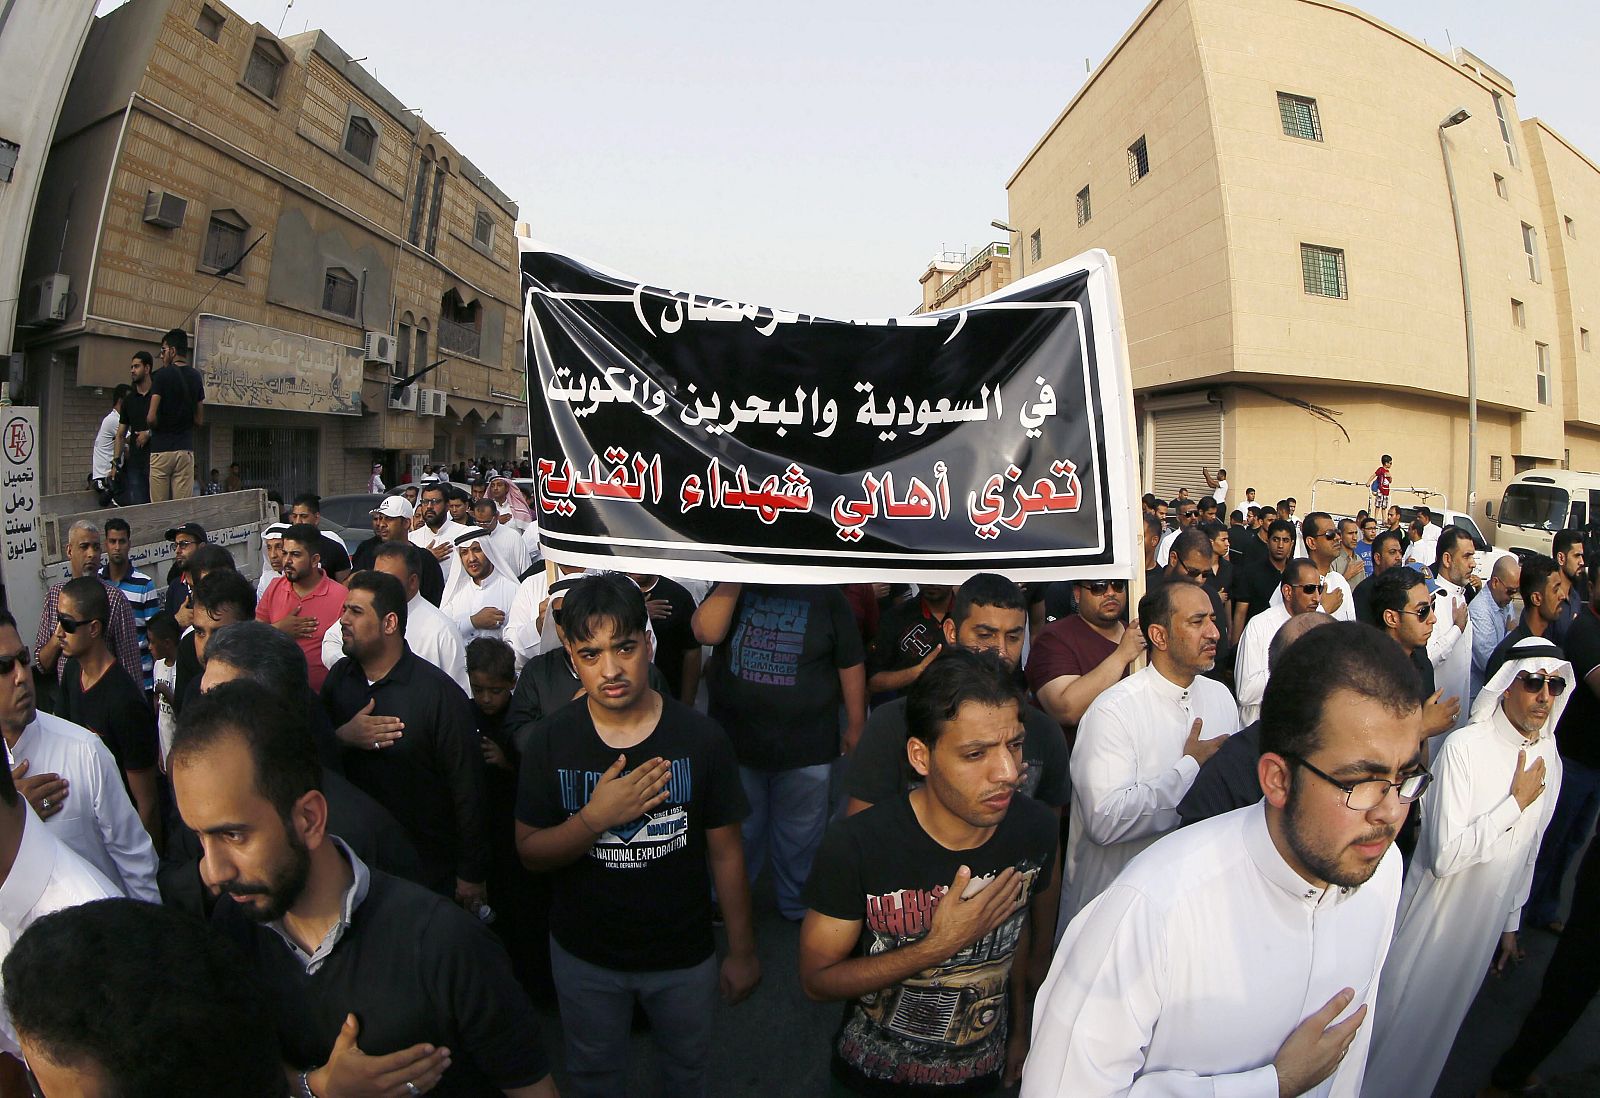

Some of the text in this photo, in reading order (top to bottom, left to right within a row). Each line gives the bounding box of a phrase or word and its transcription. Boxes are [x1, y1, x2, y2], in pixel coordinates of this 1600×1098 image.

[547, 366, 1057, 442] في السعودية والبحرين والكويت
[3, 466, 34, 488] تحميل
[5, 493, 34, 514] رمل
[536, 446, 1083, 543] تعزي أهالي شهداء القديح
[5, 516, 36, 536] اسمنت
[229, 528, 251, 540] مؤسسة
[7, 540, 38, 560] طابوق
[596, 848, 636, 862] NATIONAL
[636, 834, 687, 861] EXPLORATION
